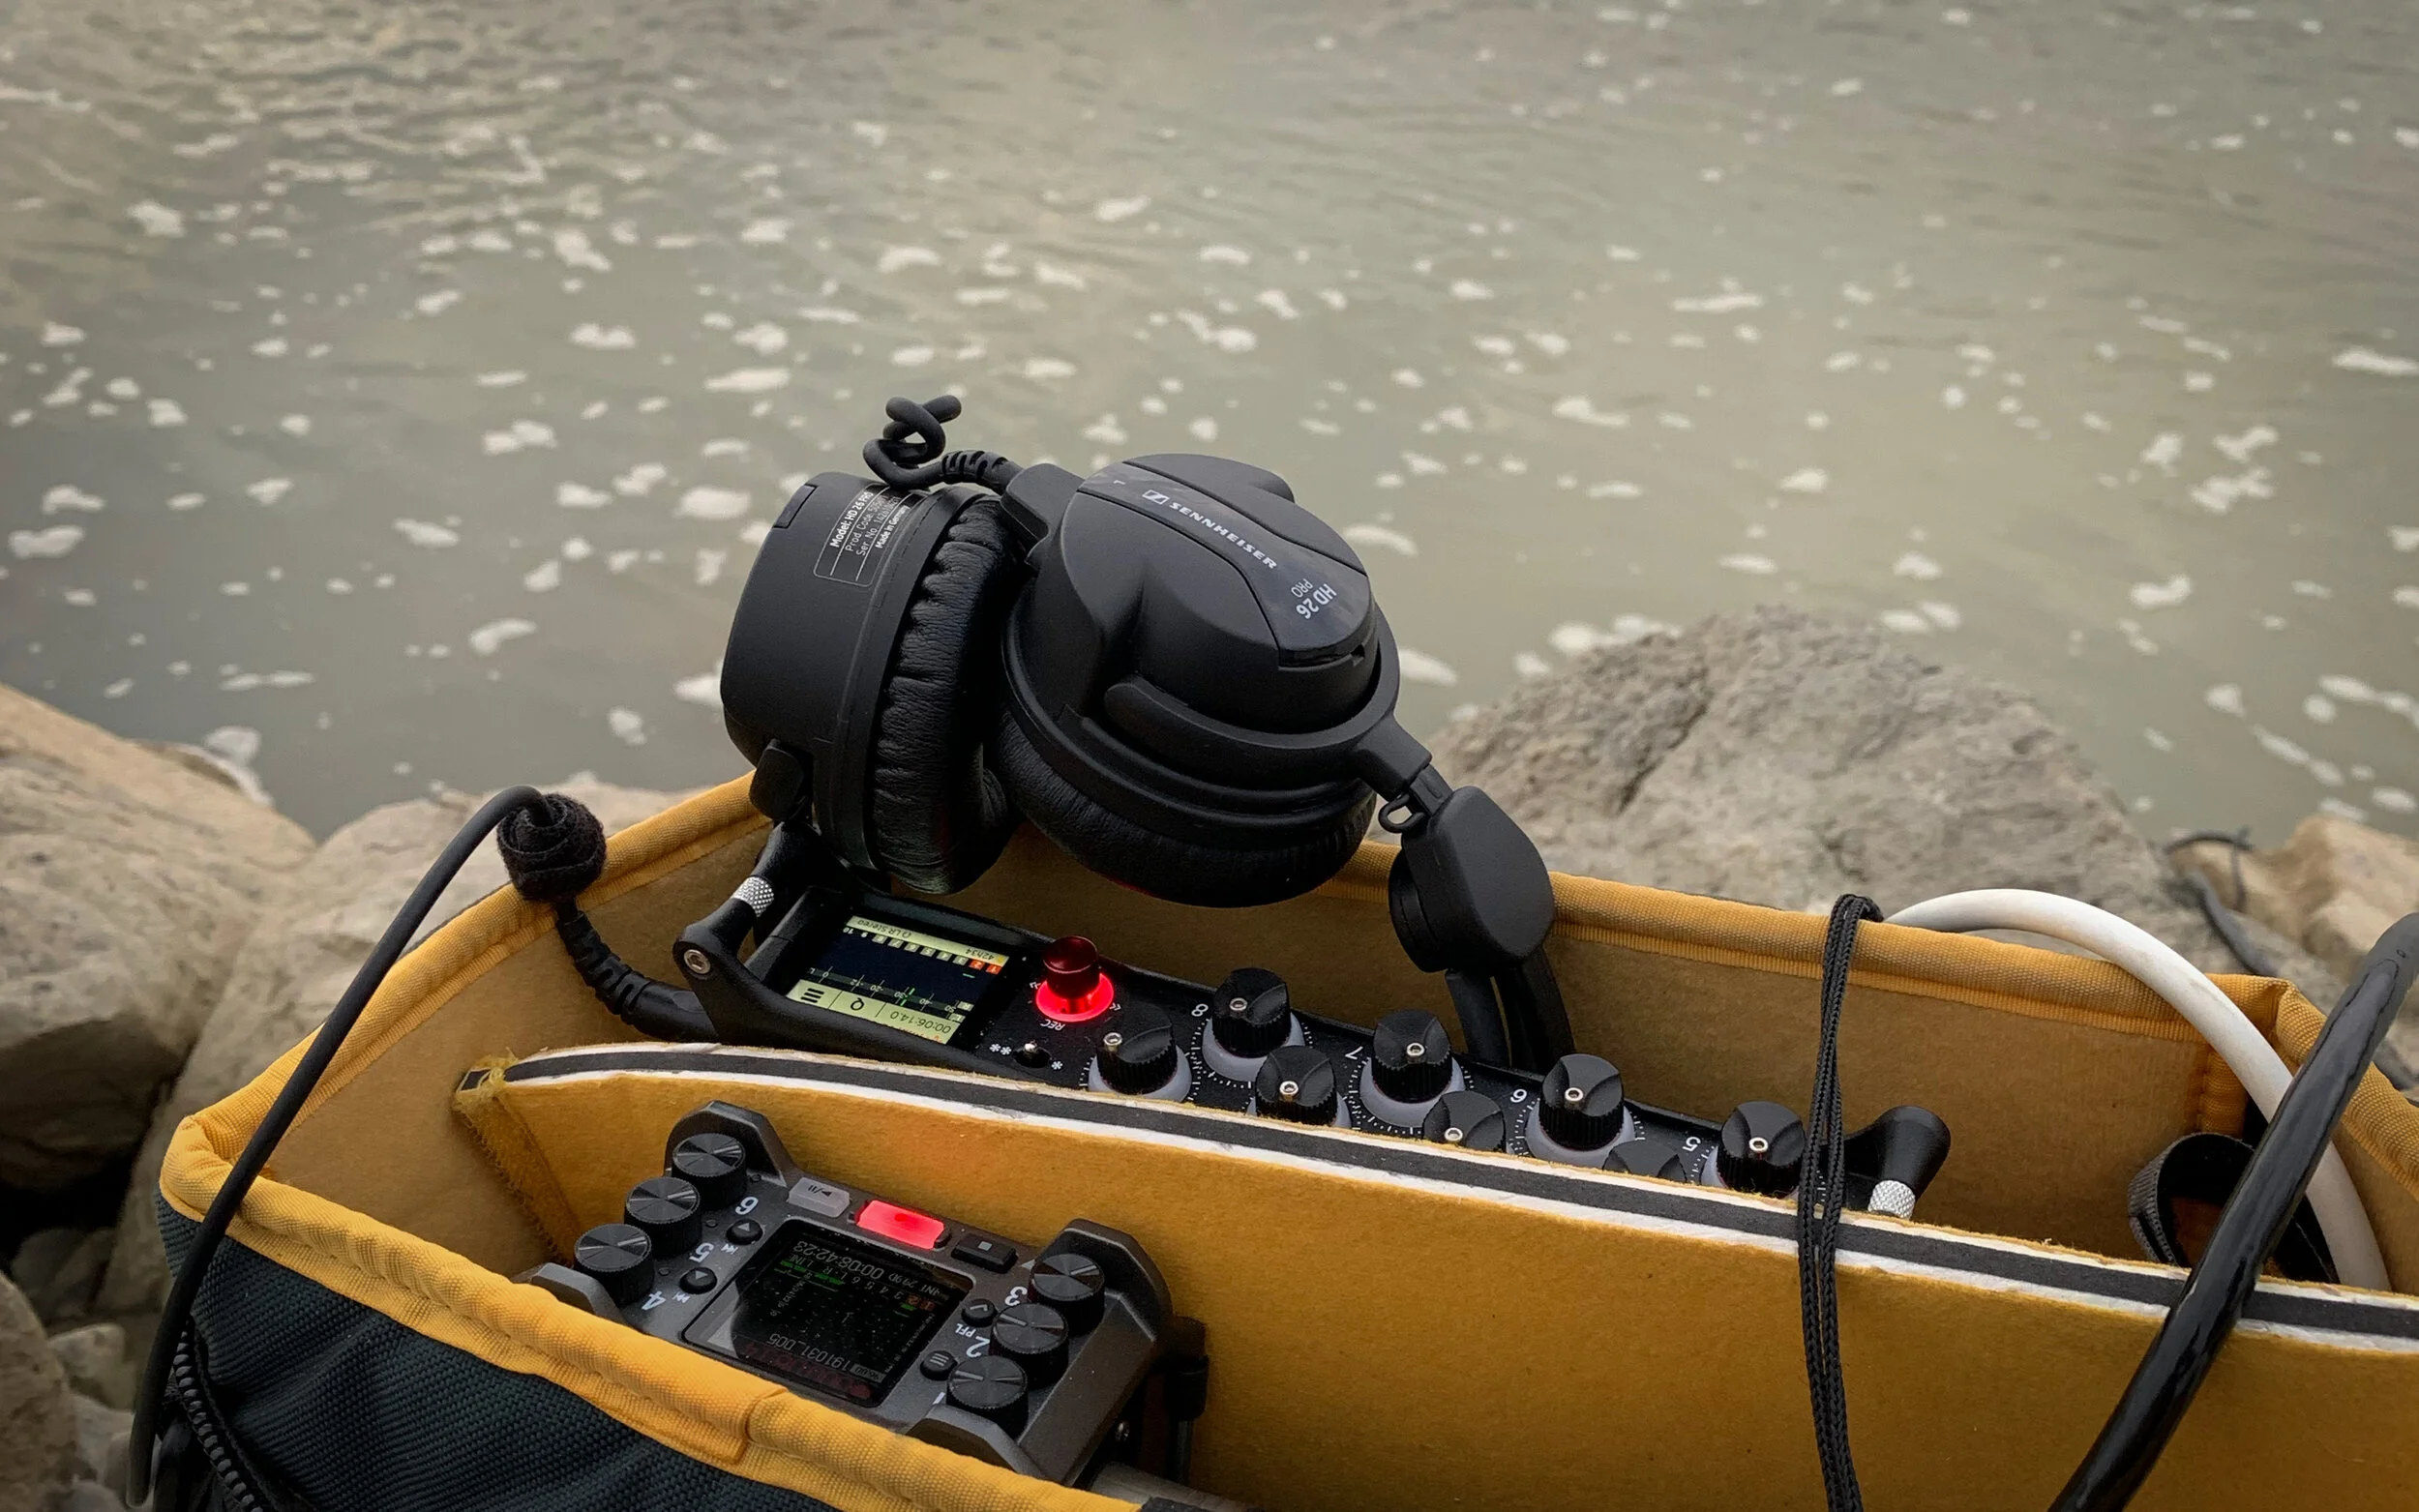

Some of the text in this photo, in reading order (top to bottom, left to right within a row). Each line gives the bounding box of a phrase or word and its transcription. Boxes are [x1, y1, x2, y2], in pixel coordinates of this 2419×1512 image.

[829, 519, 852, 548] Model:
[844, 509, 858, 520] HD
[1169, 501, 1277, 570] SENNHEISER
[1291, 578, 1313, 598] PRO
[1296, 583, 1337, 619] HD 26
[1191, 1003, 1209, 1017] 8
[890, 1011, 951, 1034] 00:06:14.0
[1040, 1019, 1066, 1032] REC
[1509, 1088, 1528, 1103] 6
[1682, 1136, 1701, 1152] 5
[735, 1196, 760, 1215] 6
[689, 1242, 714, 1262] 5
[642, 1290, 666, 1311] 4
[1004, 1286, 1028, 1307] 3
[954, 1322, 976, 1338] PFL
[766, 1333, 851, 1372] 191031_005
[966, 1335, 991, 1358] 2
